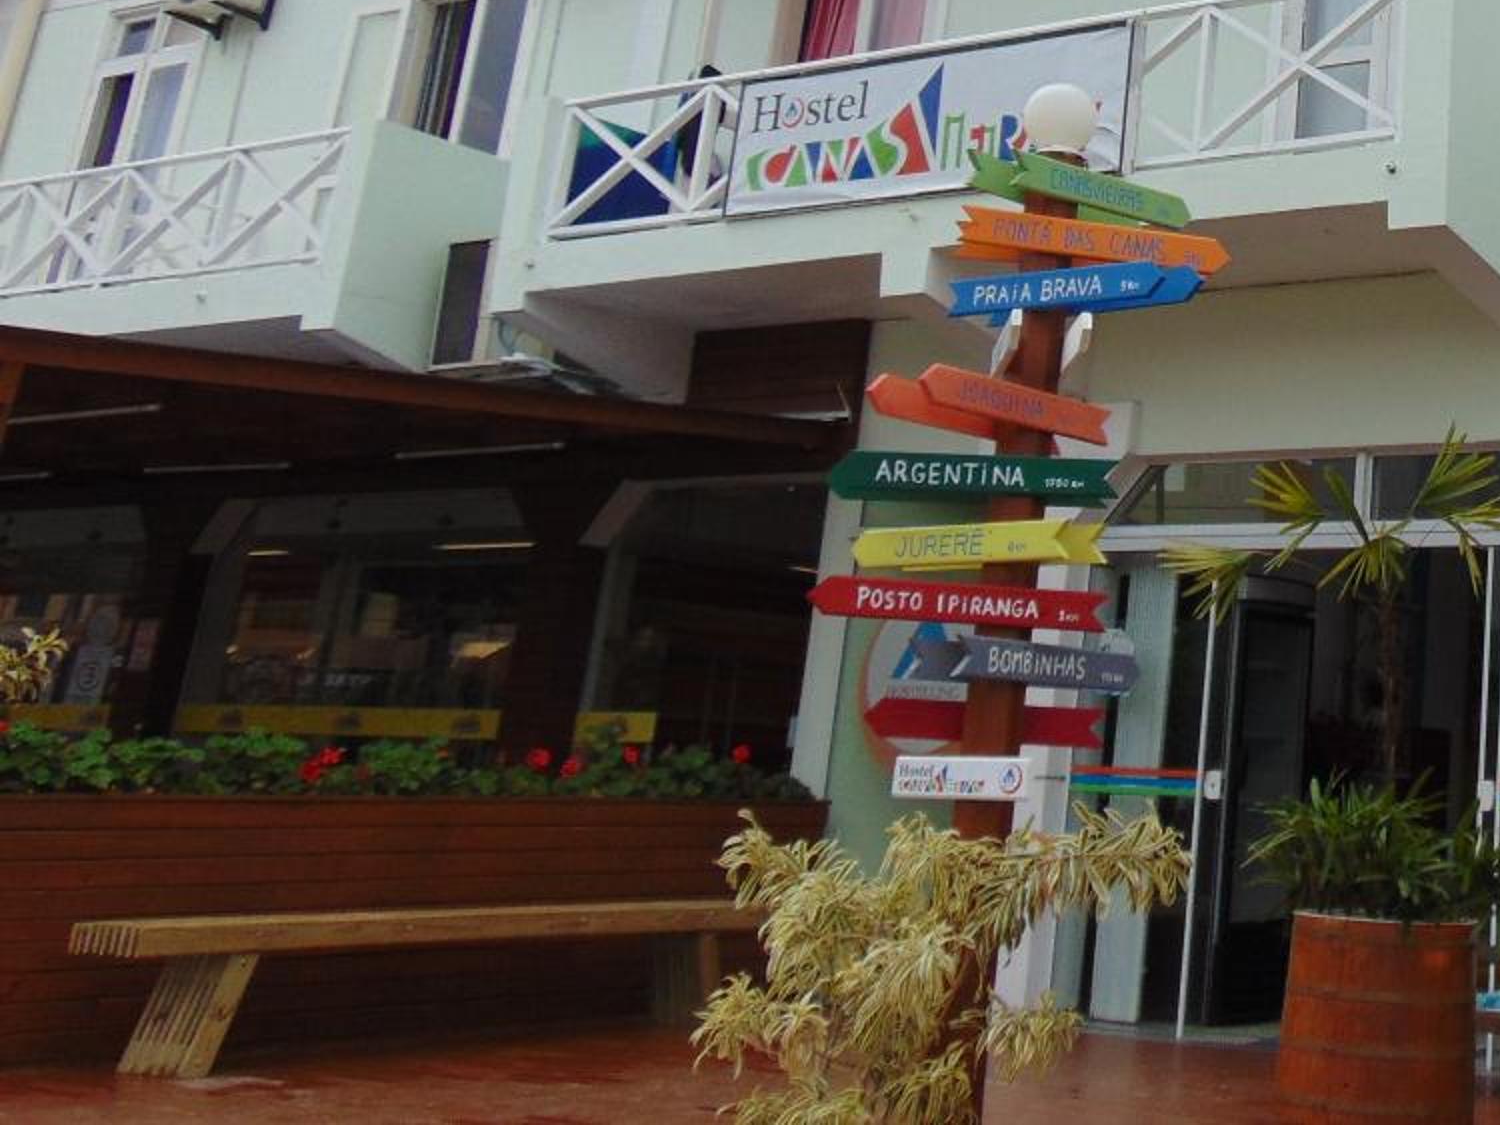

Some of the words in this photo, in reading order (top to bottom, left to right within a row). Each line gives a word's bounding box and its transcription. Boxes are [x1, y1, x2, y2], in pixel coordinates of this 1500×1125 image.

[751, 80, 869, 134] Hostel
[1040, 274, 1102, 302] BRAVA
[856, 586, 923, 611] POSTO
